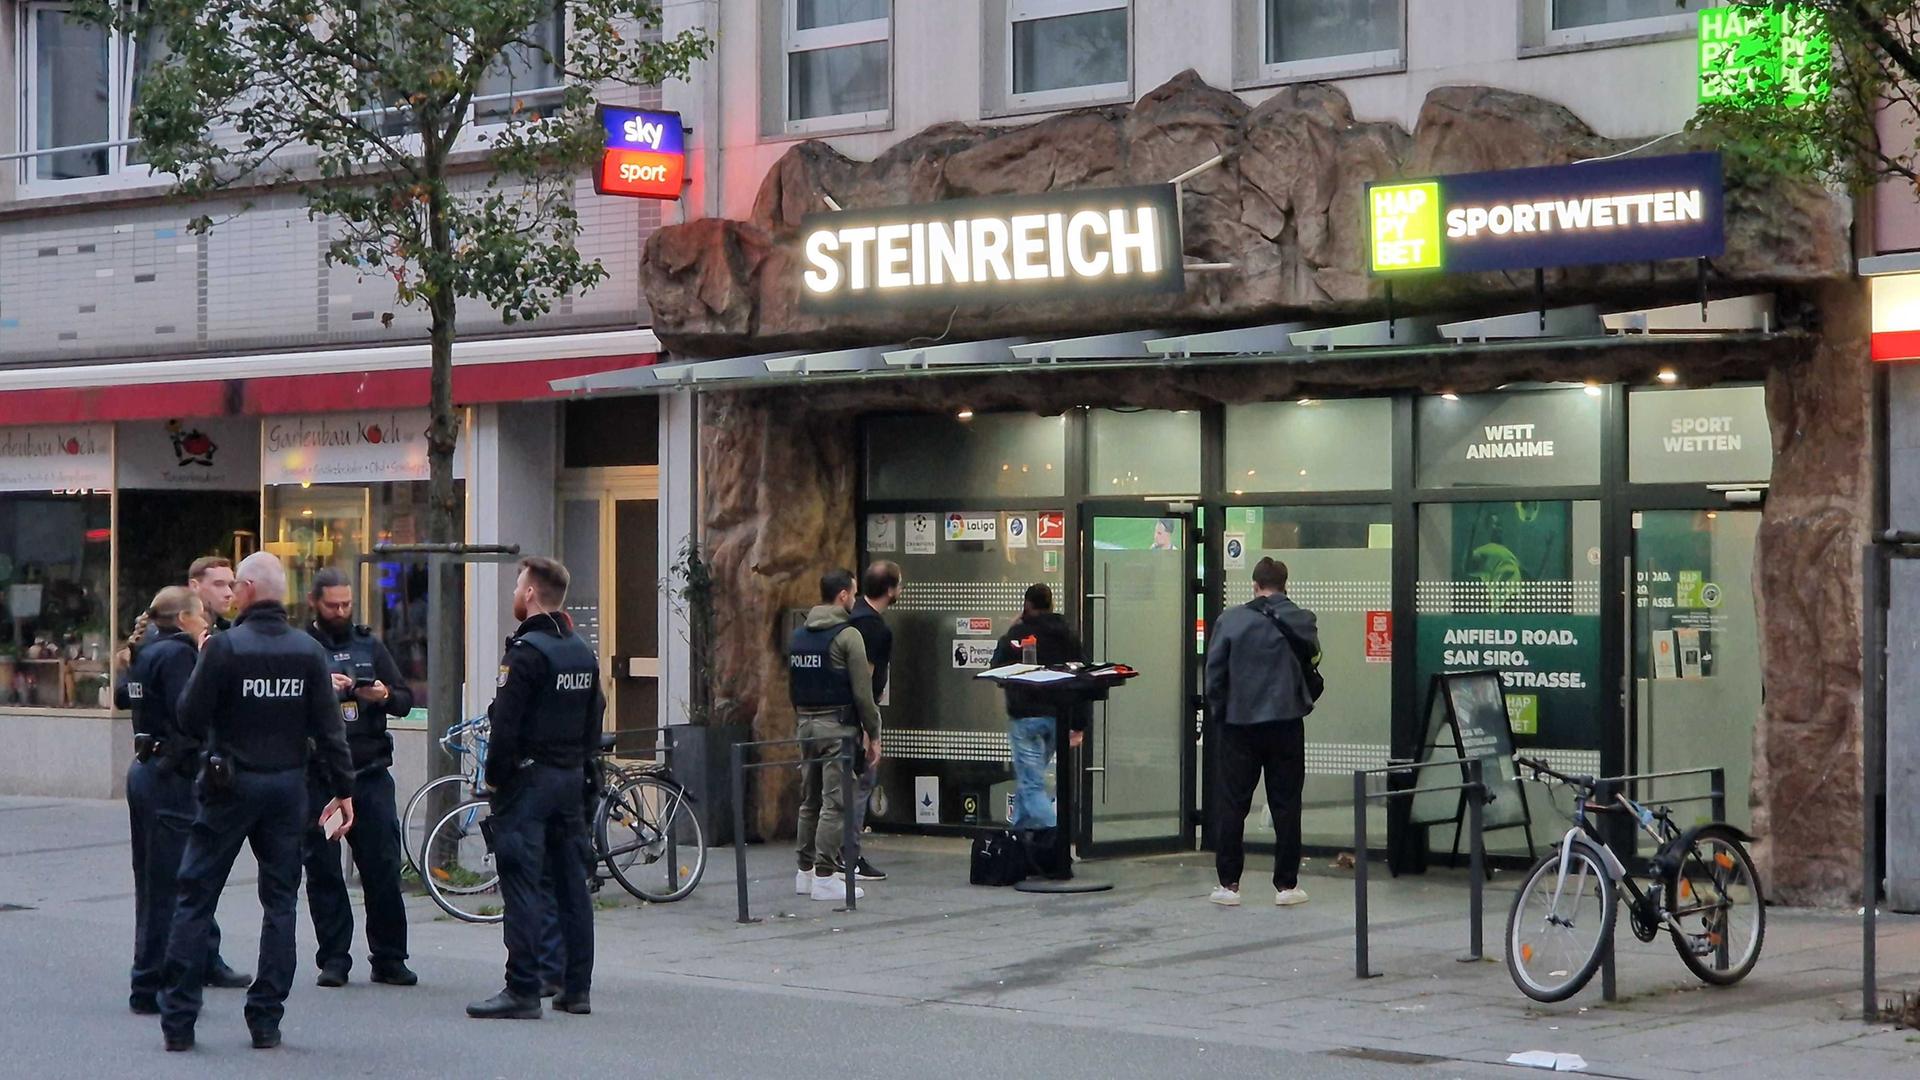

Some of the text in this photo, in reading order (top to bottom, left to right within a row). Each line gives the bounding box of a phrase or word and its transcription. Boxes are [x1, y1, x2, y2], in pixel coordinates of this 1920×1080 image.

[623, 115, 664, 150] sky
[619, 163, 667, 183] sport
[1375, 189, 1427, 217] HAP
[1445, 189, 1702, 238] SPORTWETTEN
[1376, 215, 1409, 241] PY
[804, 206, 1161, 294] STEINREICH
[1376, 238, 1425, 267] BET
[1484, 423, 1536, 441] WETT
[1671, 416, 1733, 434] SPORT
[268, 419, 351, 452] Gartenbau
[1663, 434, 1742, 453] WETTEN
[1466, 440, 1554, 459] ANNAHME
[966, 520, 995, 532] LaLiga
[1443, 629, 1579, 646] ANFIELD ROAD.
[790, 654, 822, 668] POLIZEI
[1443, 650, 1530, 666] SAN SIRO.
[242, 678, 305, 698] POLIZEI
[556, 673, 593, 690] POLIZEI
[1507, 697, 1531, 708] HAP
